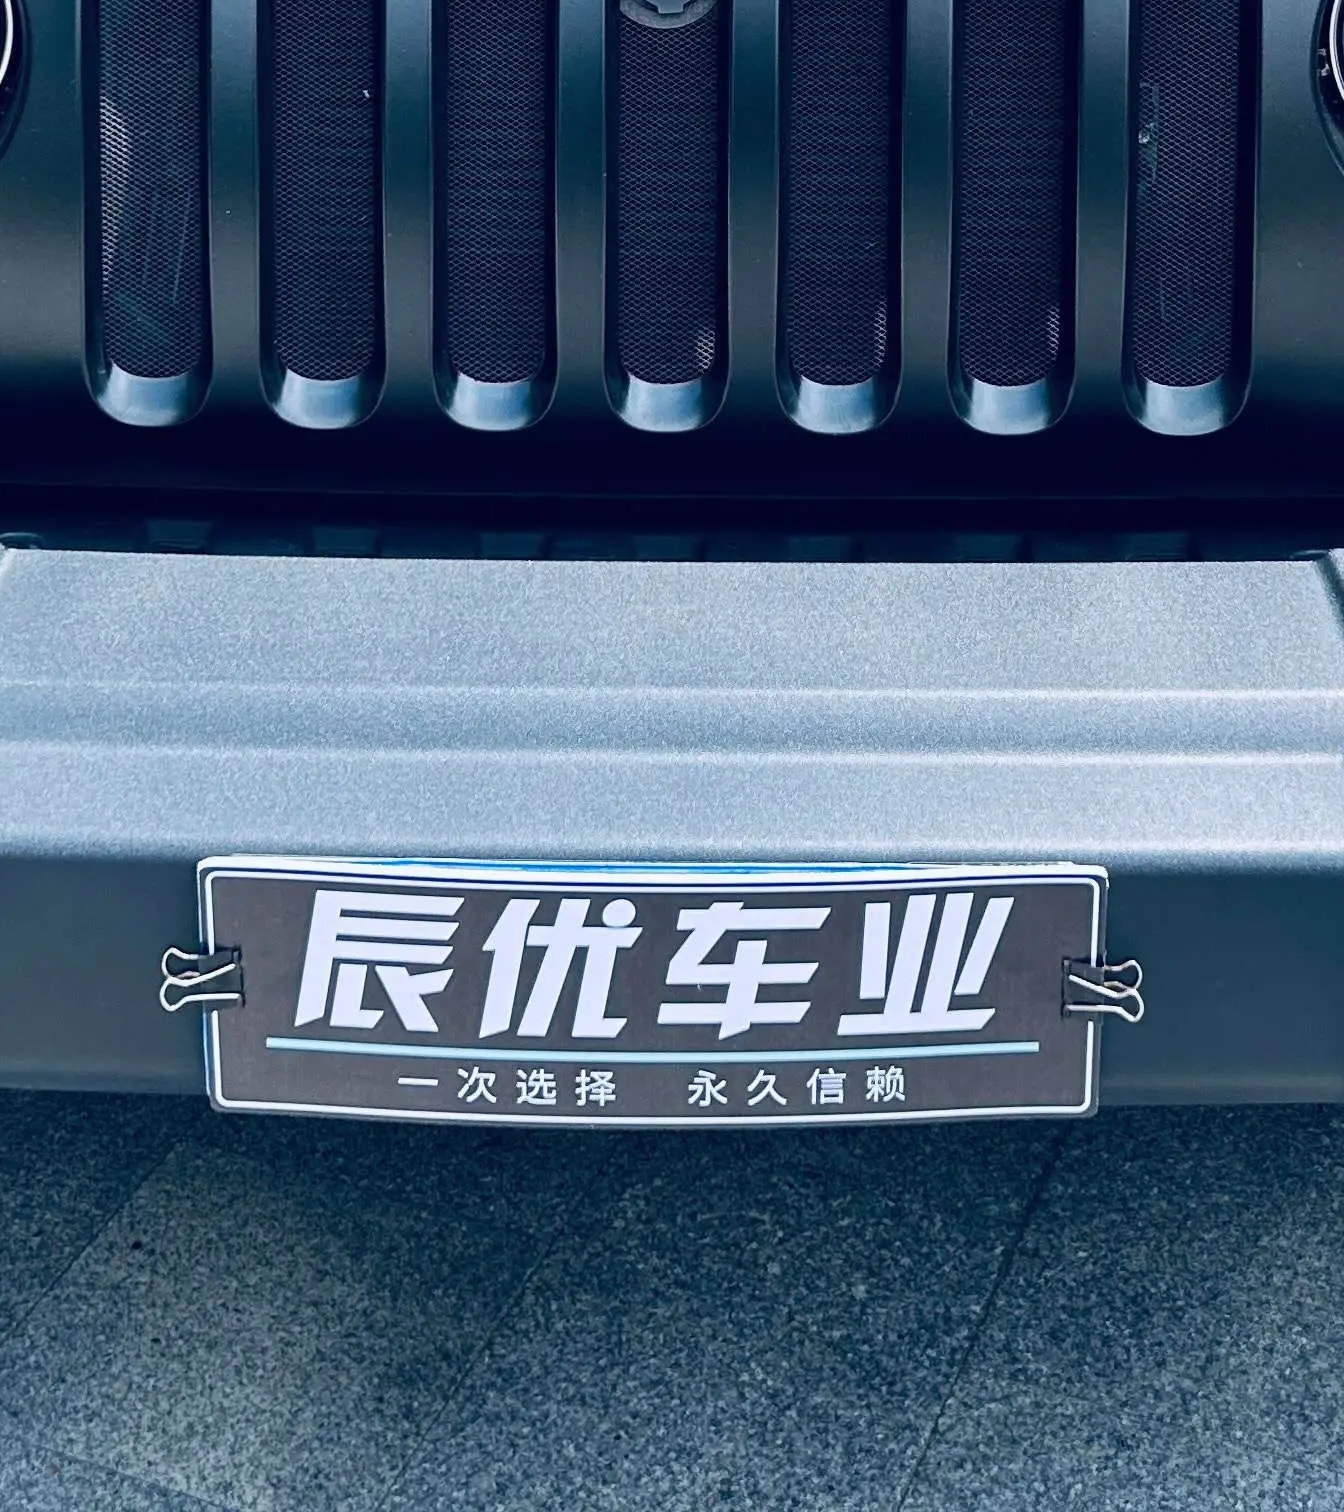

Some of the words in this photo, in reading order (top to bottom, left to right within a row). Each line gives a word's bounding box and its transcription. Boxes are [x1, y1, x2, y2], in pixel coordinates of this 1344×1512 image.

[293, 889, 1014, 1041] 辰优车业
[397, 1066, 617, 1108] 一次选择
[687, 1065, 906, 1108] 永久信赖
